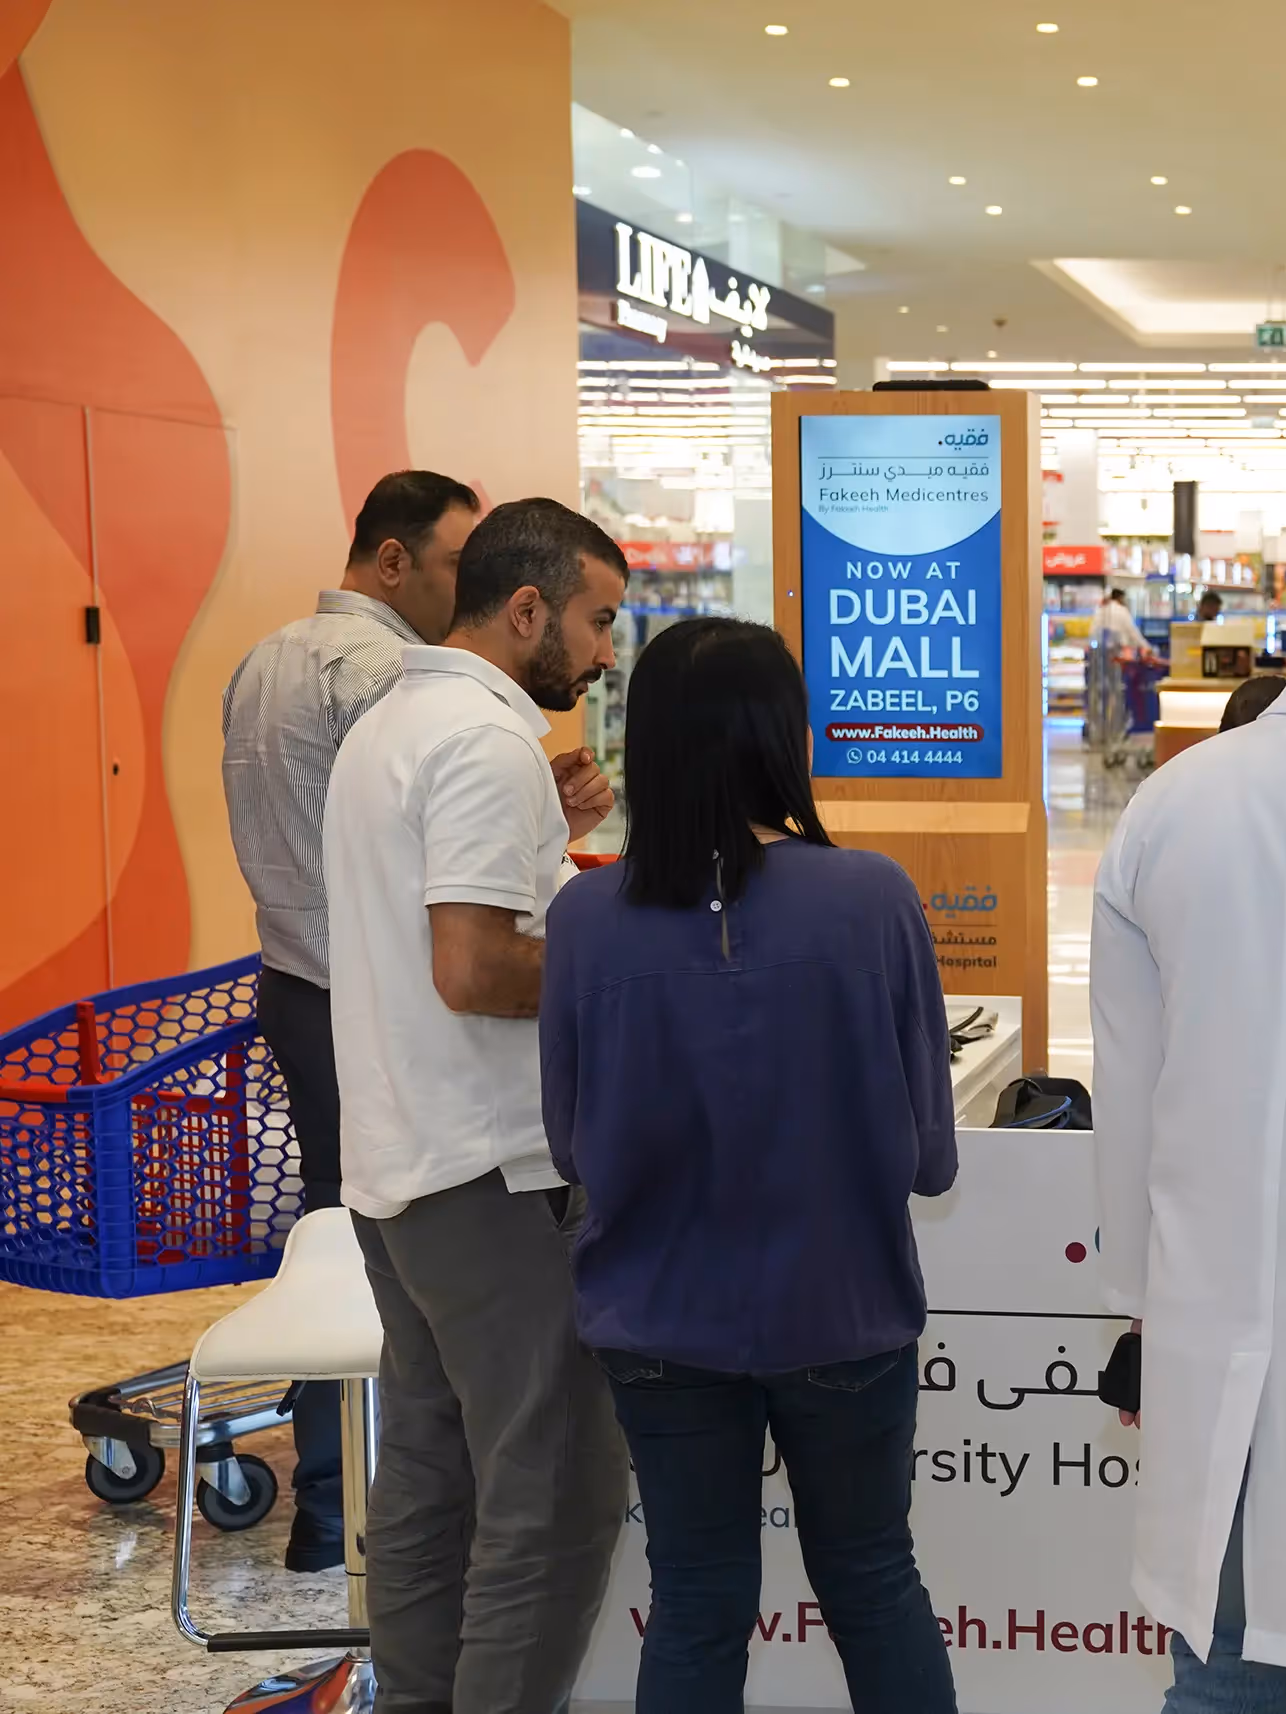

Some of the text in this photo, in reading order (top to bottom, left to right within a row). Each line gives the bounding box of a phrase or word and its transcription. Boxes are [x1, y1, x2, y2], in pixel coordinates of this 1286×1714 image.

[947, 462, 989, 480] فقيه
[819, 488, 989, 502] Fakeeh Medicentres
[862, 504, 889, 513] Health
[846, 561, 961, 580] NOW AT
[829, 588, 977, 625] DUBAI
[830, 636, 980, 679] MALL
[829, 689, 980, 715] ZABEEL, P6
[831, 725, 979, 741] www.Fakeeh.Health
[867, 750, 963, 764] 04 414 4444
